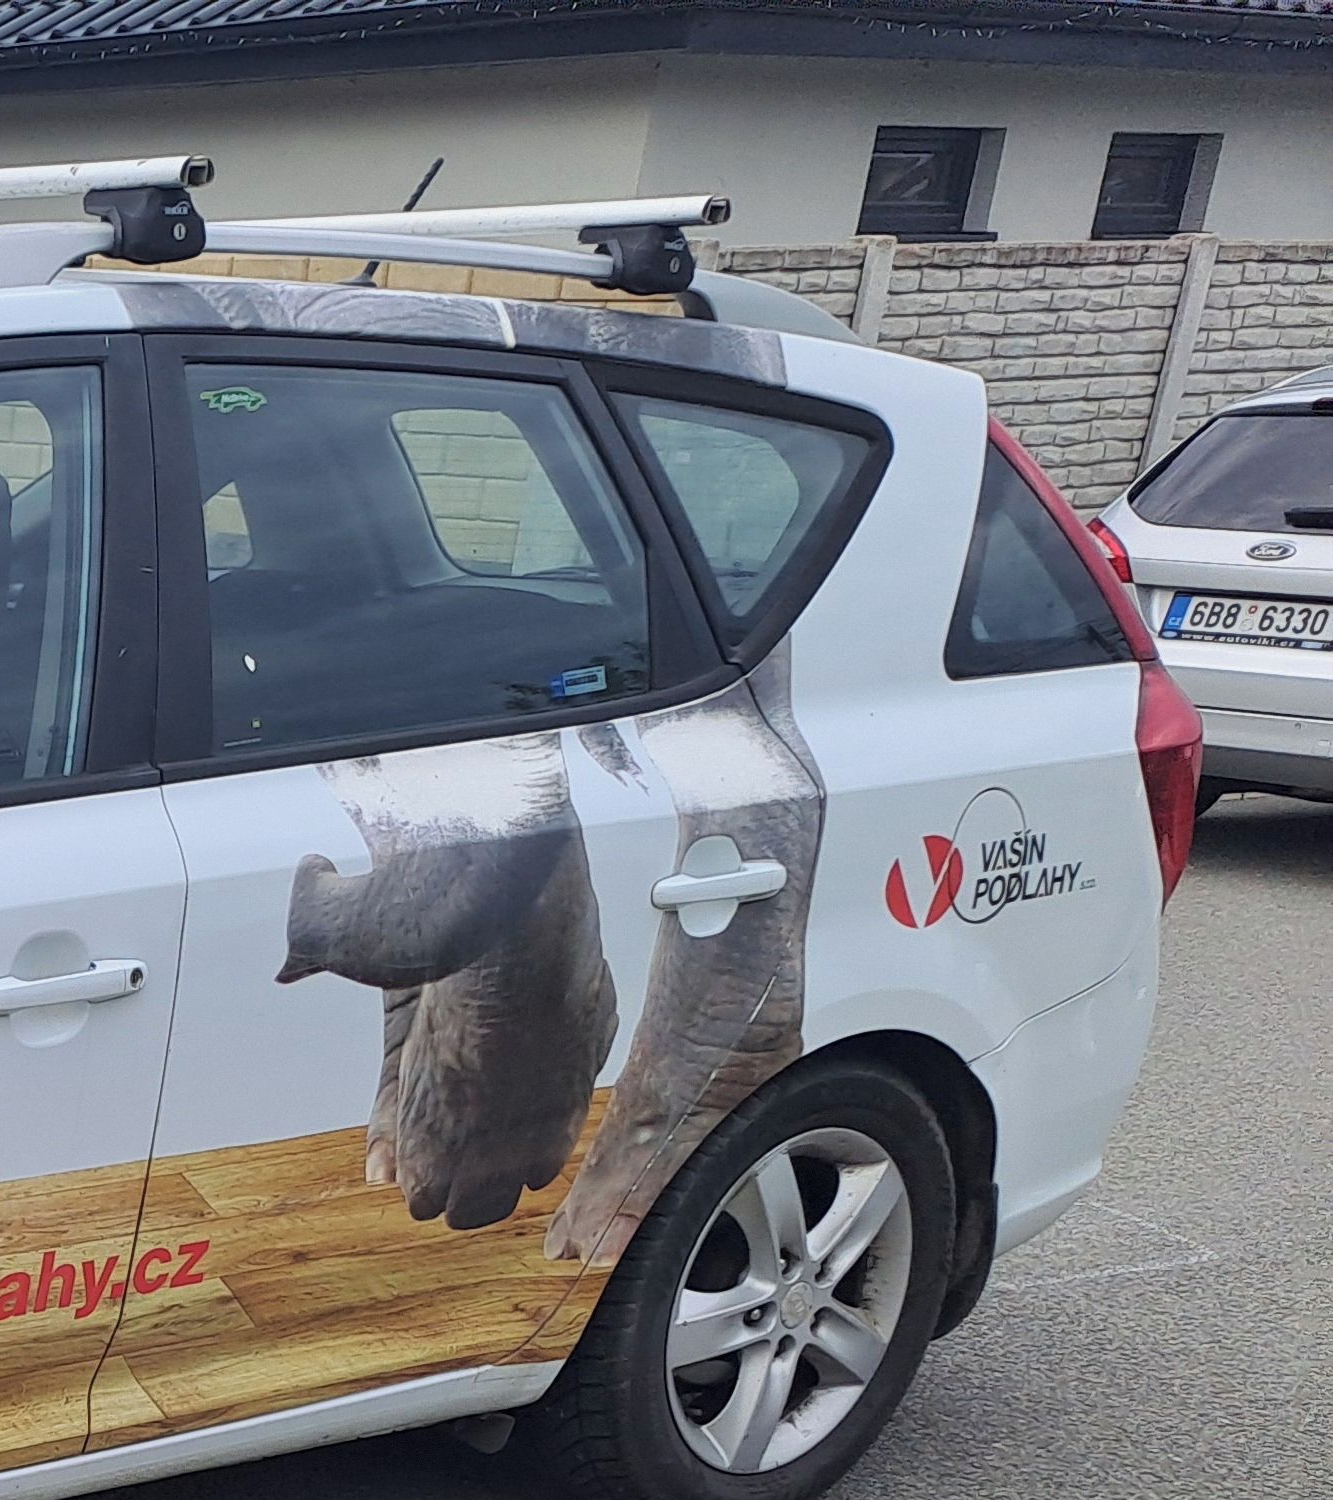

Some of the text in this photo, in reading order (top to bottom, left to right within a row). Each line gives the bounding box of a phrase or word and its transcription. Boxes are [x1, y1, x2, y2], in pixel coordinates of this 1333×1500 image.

[1189, 601, 1330, 636] 6B8 6330
[981, 828, 1046, 873] VAŠÍN
[972, 861, 1083, 910] PODLAHY
